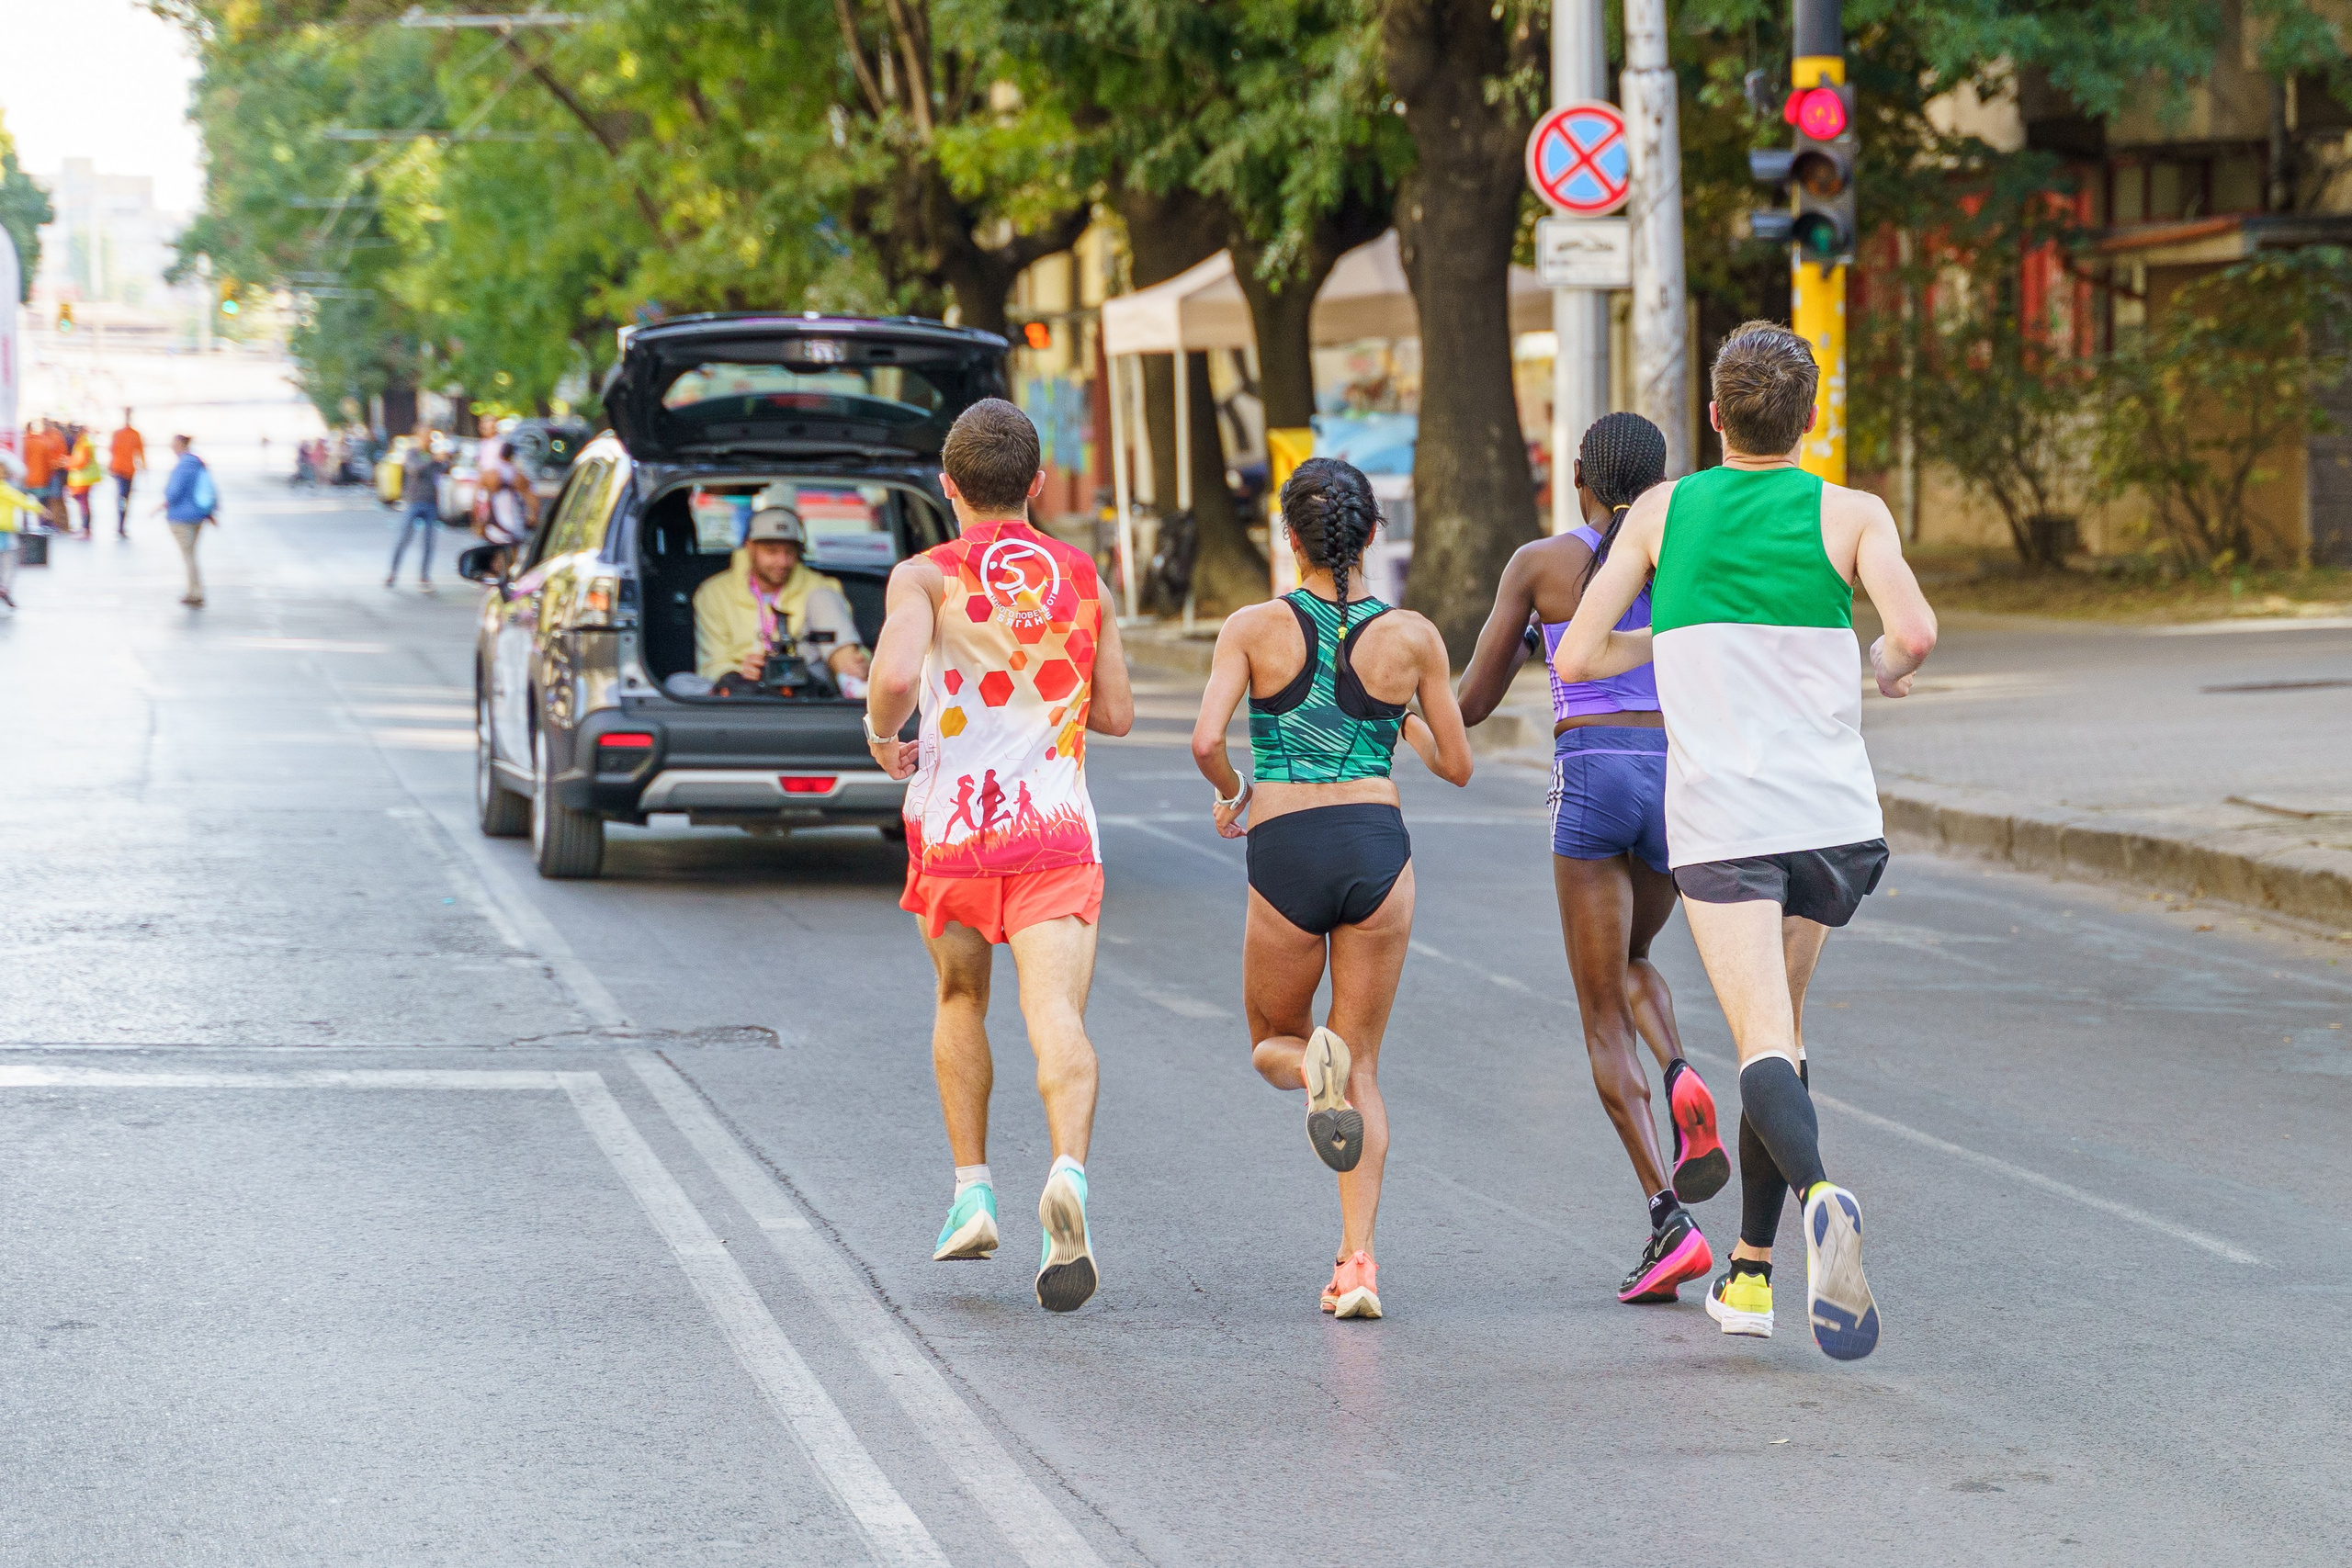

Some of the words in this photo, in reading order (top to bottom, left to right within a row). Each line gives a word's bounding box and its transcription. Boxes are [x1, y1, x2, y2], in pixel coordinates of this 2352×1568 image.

[990, 595, 1015, 618] МНОГО
[1015, 604, 1049, 619] ПОВЕЧЕ
[1046, 592, 1057, 606] ОТ
[996, 611, 1054, 628] БЯГАНЕ
